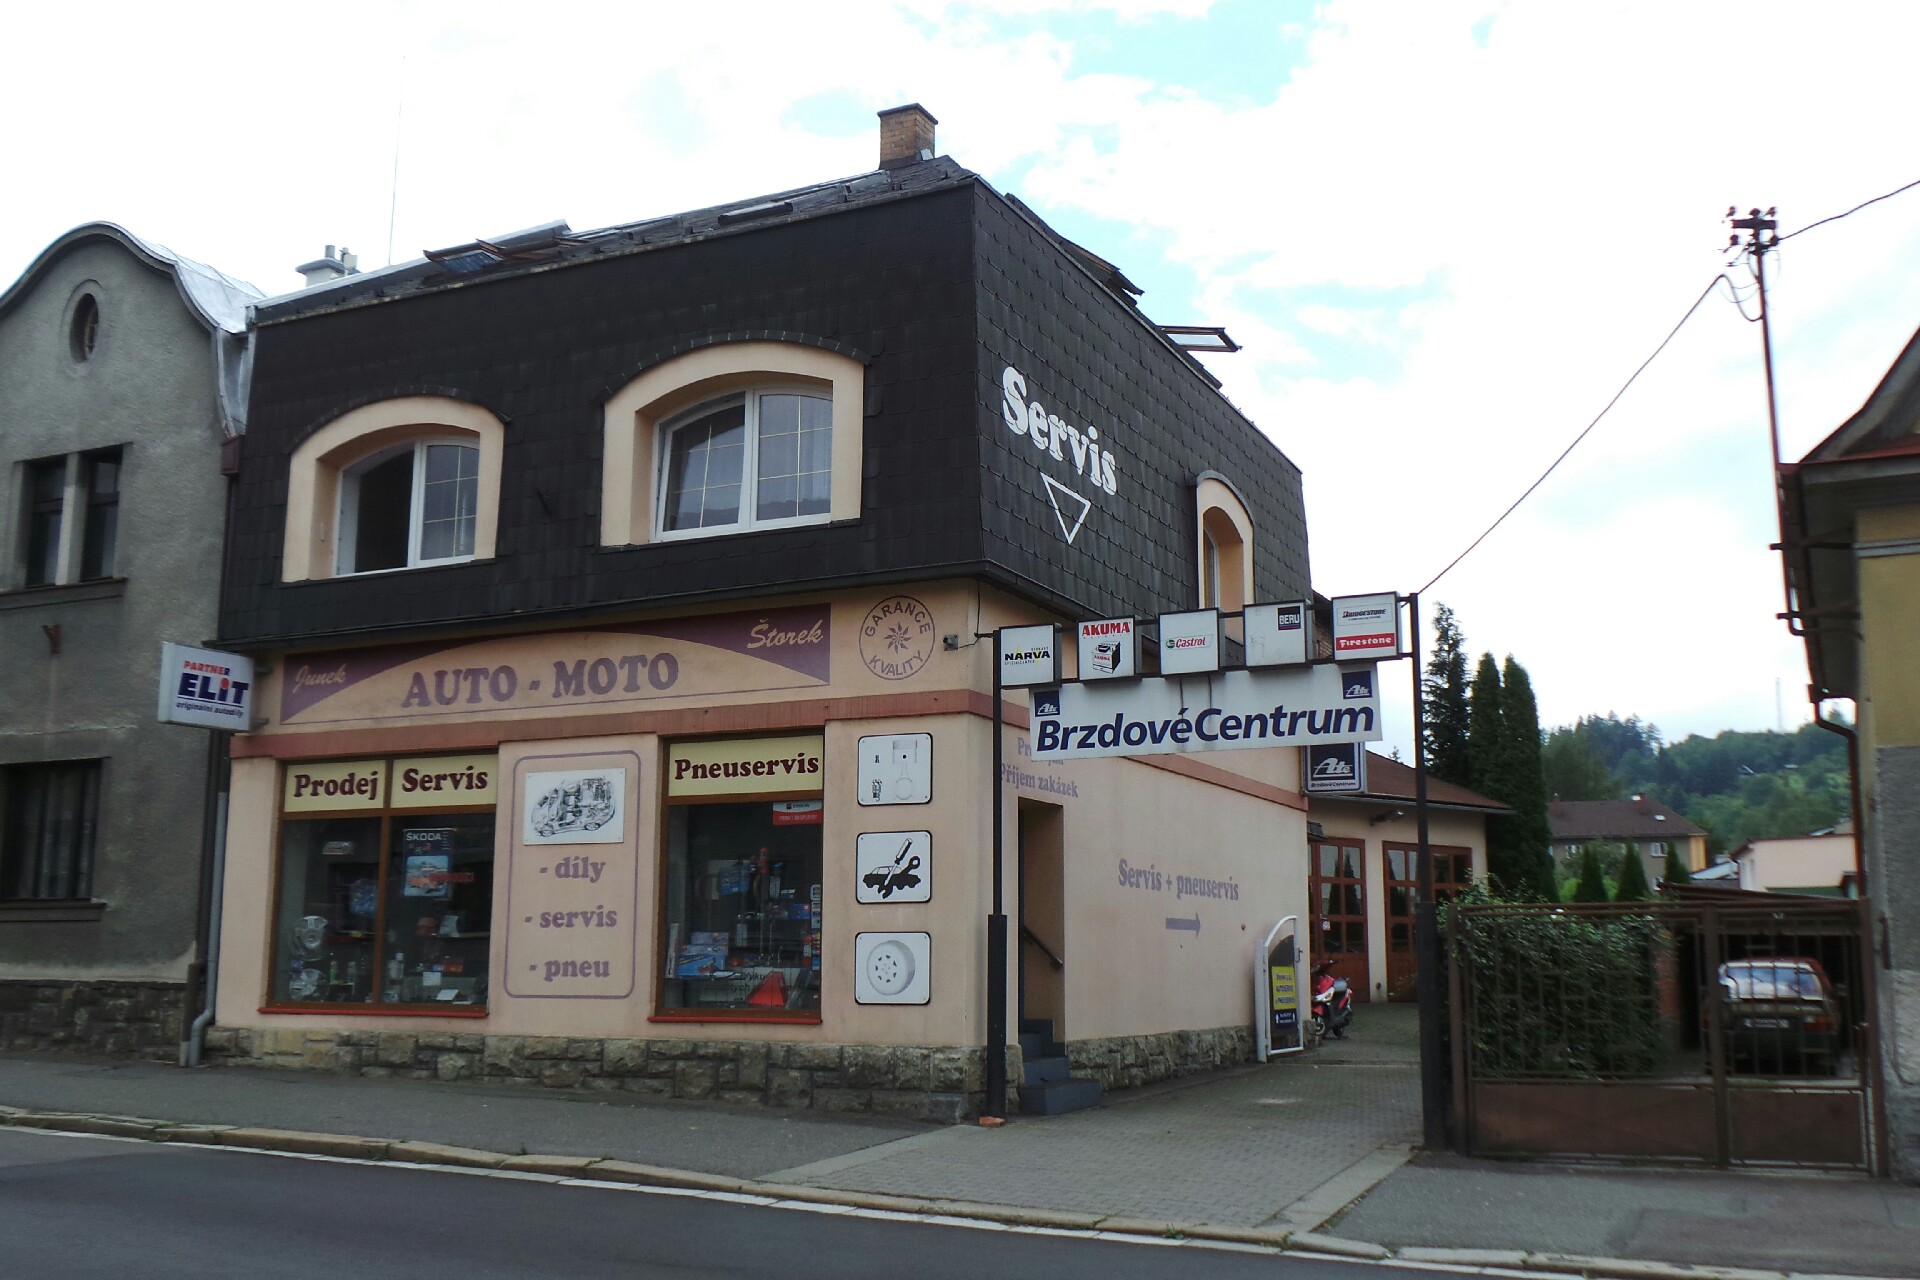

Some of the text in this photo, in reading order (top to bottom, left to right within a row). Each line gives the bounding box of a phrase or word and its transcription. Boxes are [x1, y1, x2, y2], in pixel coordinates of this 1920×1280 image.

[1002, 366, 1117, 496] Servis
[864, 602, 931, 637] GARANCE
[1082, 621, 1130, 636] AKUMA
[1279, 613, 1300, 625] BERU
[746, 618, 824, 649] Štorek
[1176, 636, 1206, 648] Castrol
[1340, 636, 1392, 648] Firestone
[868, 650, 924, 677] KVALITY
[1004, 650, 1051, 661] NARVA
[183, 660, 231, 677] PARTNER
[402, 664, 518, 708] AUTO
[552, 652, 680, 699] MOTO
[674, 752, 819, 780] Pneuservis
[1313, 757, 1353, 777] Ate
[293, 771, 379, 801] Prodej
[402, 765, 488, 793] Servis
[1038, 775, 1079, 798] zakázek
[406, 831, 442, 841] ŠKODA
[1118, 858, 1163, 892] Servis
[1176, 874, 1240, 901] pneuservis
[539, 904, 618, 929] servis
[543, 958, 611, 981] pneu
